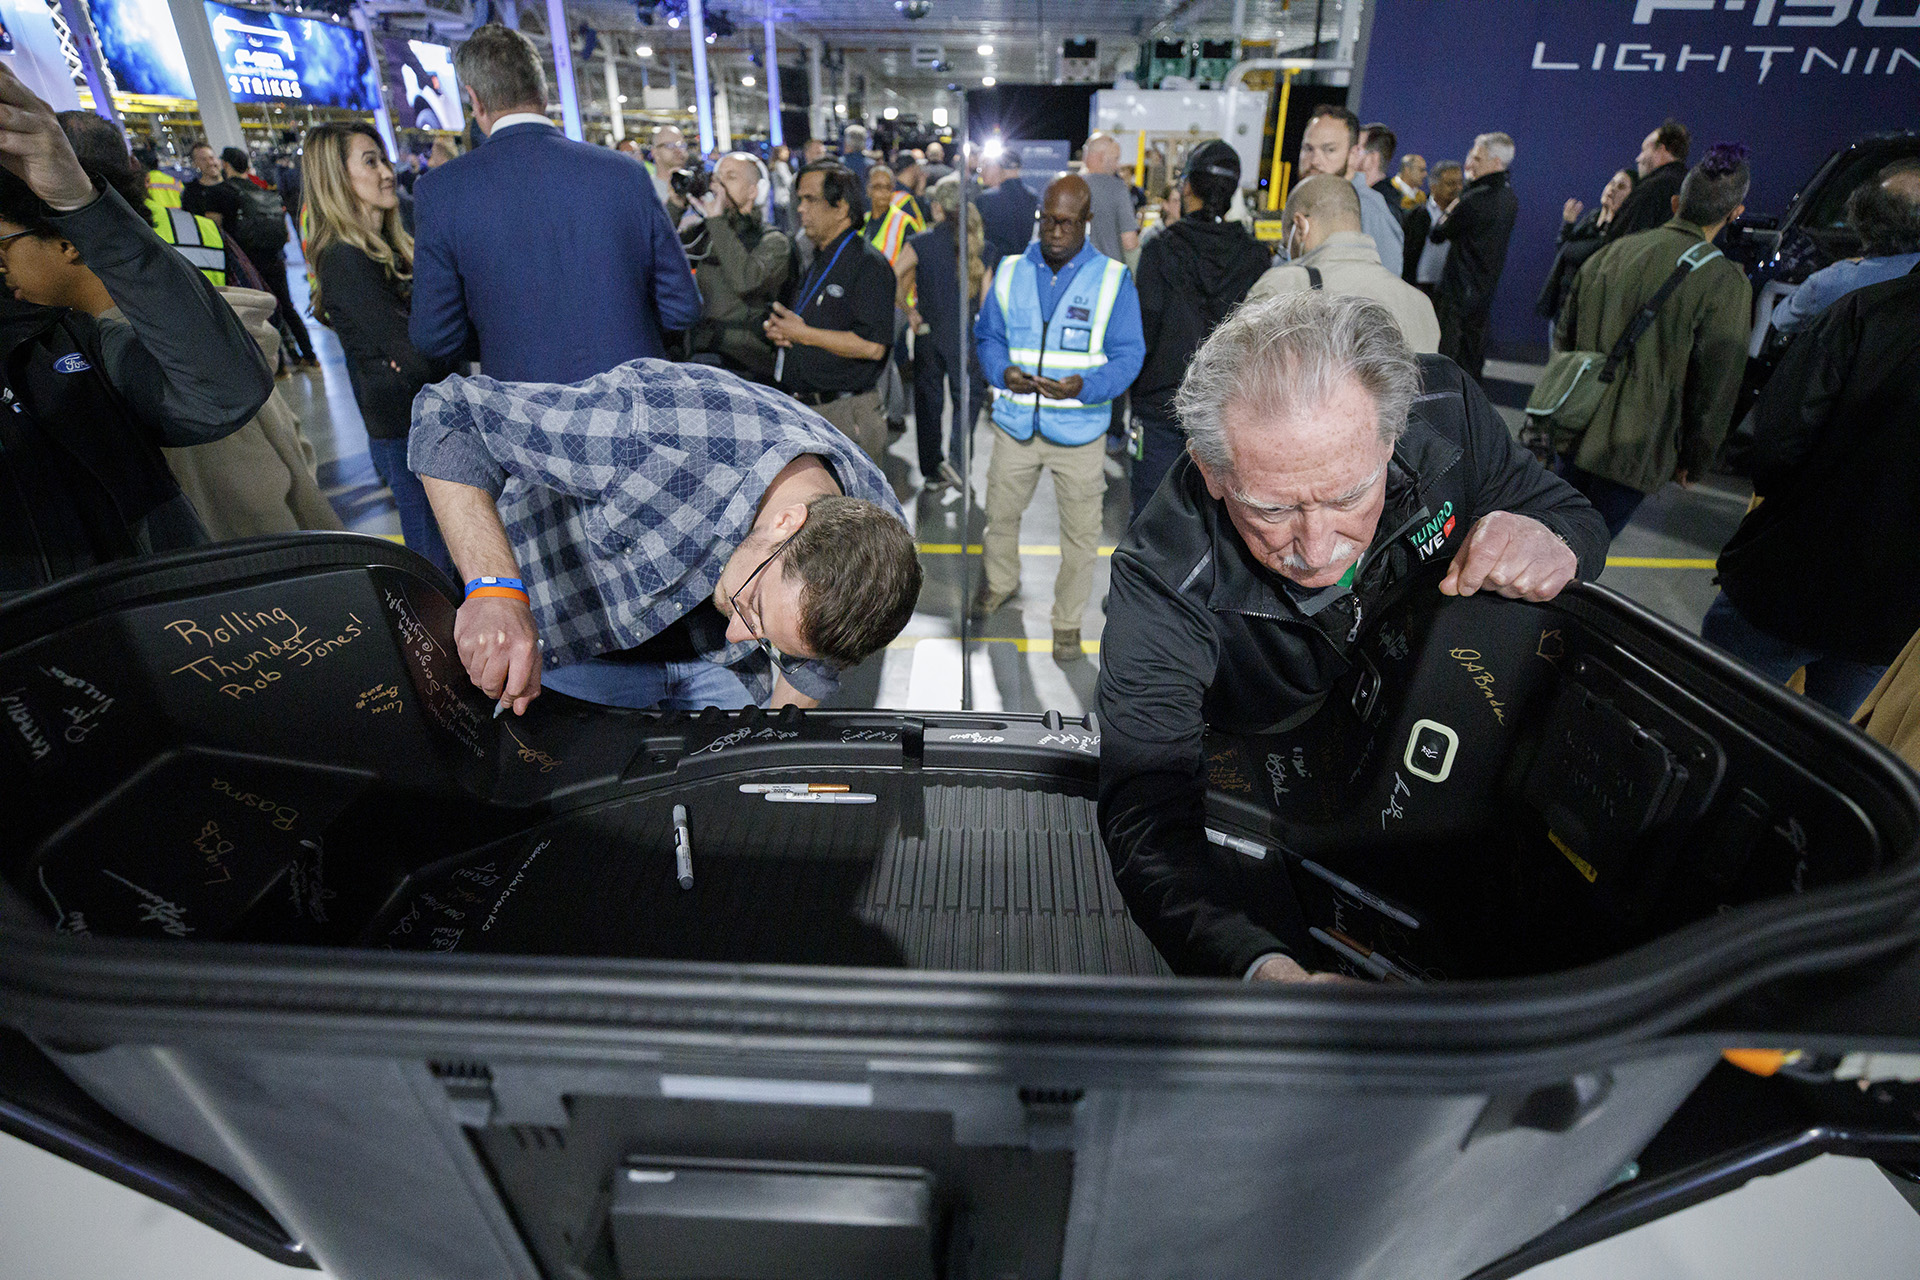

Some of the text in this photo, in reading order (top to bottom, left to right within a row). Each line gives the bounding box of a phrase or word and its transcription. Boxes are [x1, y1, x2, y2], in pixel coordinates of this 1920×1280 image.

[228, 74, 303, 99] STRIKES
[164, 607, 300, 647] Rolling
[171, 626, 307, 682] Thunder
[219, 612, 371, 699] Rob Jones!
[521, 839, 551, 870] Rebecca
